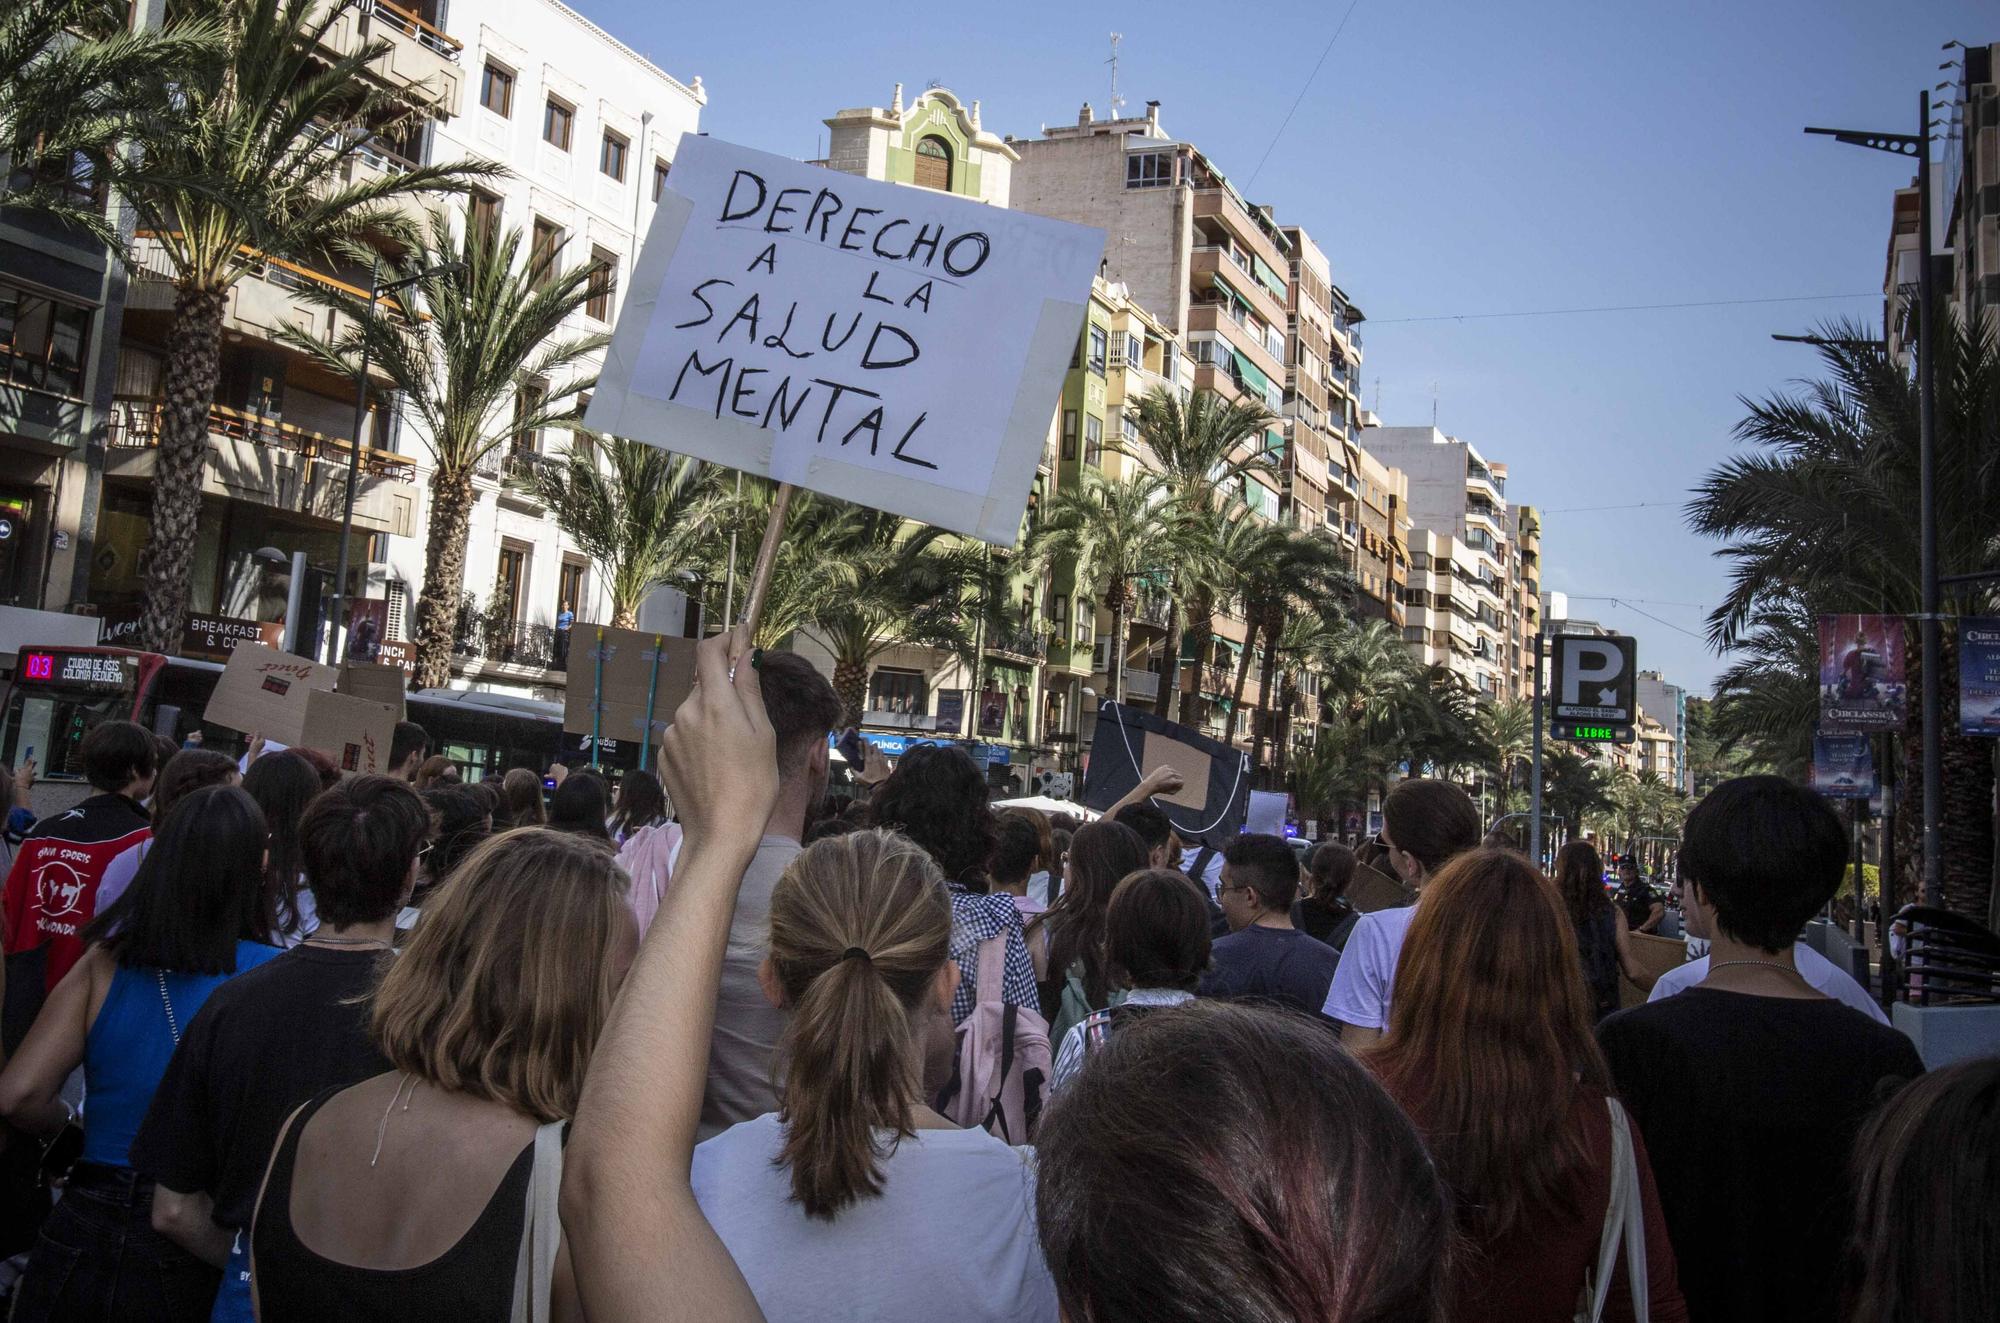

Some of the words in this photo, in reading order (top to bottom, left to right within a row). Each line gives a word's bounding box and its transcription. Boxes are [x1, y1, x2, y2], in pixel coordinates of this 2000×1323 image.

[720, 170, 990, 278] DERECHO
[748, 243, 777, 275] A
[862, 271, 933, 314] LA
[675, 279, 920, 369] SALUD
[669, 350, 938, 470] MENTAL
[191, 619, 262, 639] BREAKFAST
[206, 634, 215, 646] &
[30, 656, 50, 676] 03
[67, 657, 93, 669] CIUDAD
[93, 659, 102, 670] DE
[103, 660, 120, 671] ASIS
[1562, 639, 1624, 704] P
[62, 668, 91, 680] COLONIA
[91, 670, 123, 683] REQUENA
[1575, 727, 1612, 738] LIBRE
[60, 848, 92, 864] SPORTS
